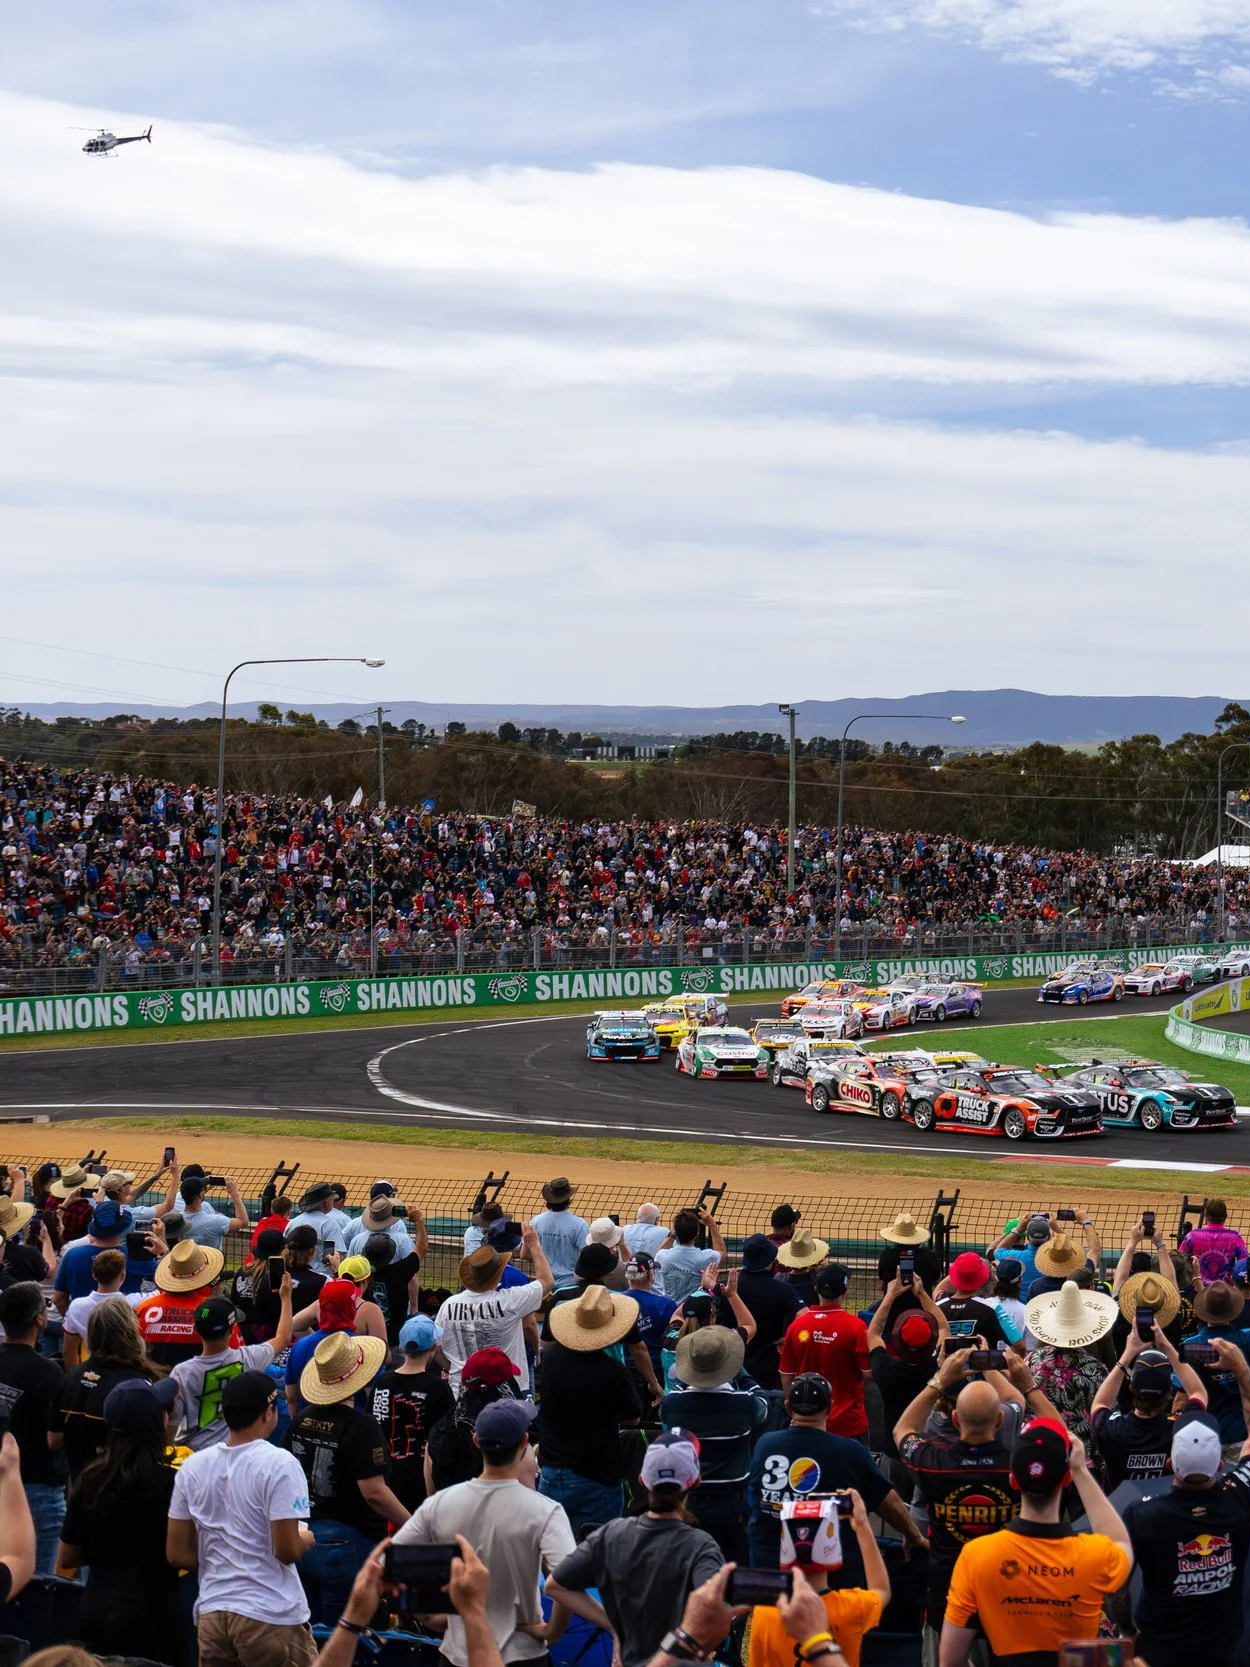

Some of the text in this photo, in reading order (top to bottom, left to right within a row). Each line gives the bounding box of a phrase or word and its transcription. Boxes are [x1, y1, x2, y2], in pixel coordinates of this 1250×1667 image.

[1012, 953, 1099, 977] SHANNONS
[1128, 948, 1204, 971] SHANNONS
[720, 963, 837, 990] SHANNONS
[876, 958, 978, 984] SHANNONS
[357, 977, 476, 1011] SHANNONS
[535, 970, 673, 1001] SHANNONS
[181, 986, 311, 1022] SHANNONS
[841, 1081, 872, 1105] CHIKO
[1097, 1093, 1130, 1114] TUS
[957, 1096, 990, 1112] TRUCK
[955, 1108, 990, 1122] ASSIST
[160, 1316, 195, 1325] ASSIST
[448, 1299, 505, 1321] NIRVANA
[160, 1325, 194, 1335] RACING
[813, 1334, 836, 1343] V-Power
[1069, 1315, 1110, 1347] ROD SHOP
[373, 1387, 382, 1424] URST
[960, 1458, 977, 1466] Since
[1126, 1454, 1166, 1469] BROWN
[761, 1489, 811, 1502] YEAR
[934, 1504, 1021, 1523] PENRITE
[1028, 1565, 1075, 1578] NEOM
[1178, 1552, 1232, 1573] Red Bull
[1173, 1564, 1237, 1584] AMPOL
[1172, 1576, 1233, 1597] RACING
[1000, 1596, 1072, 1607] McLaren
